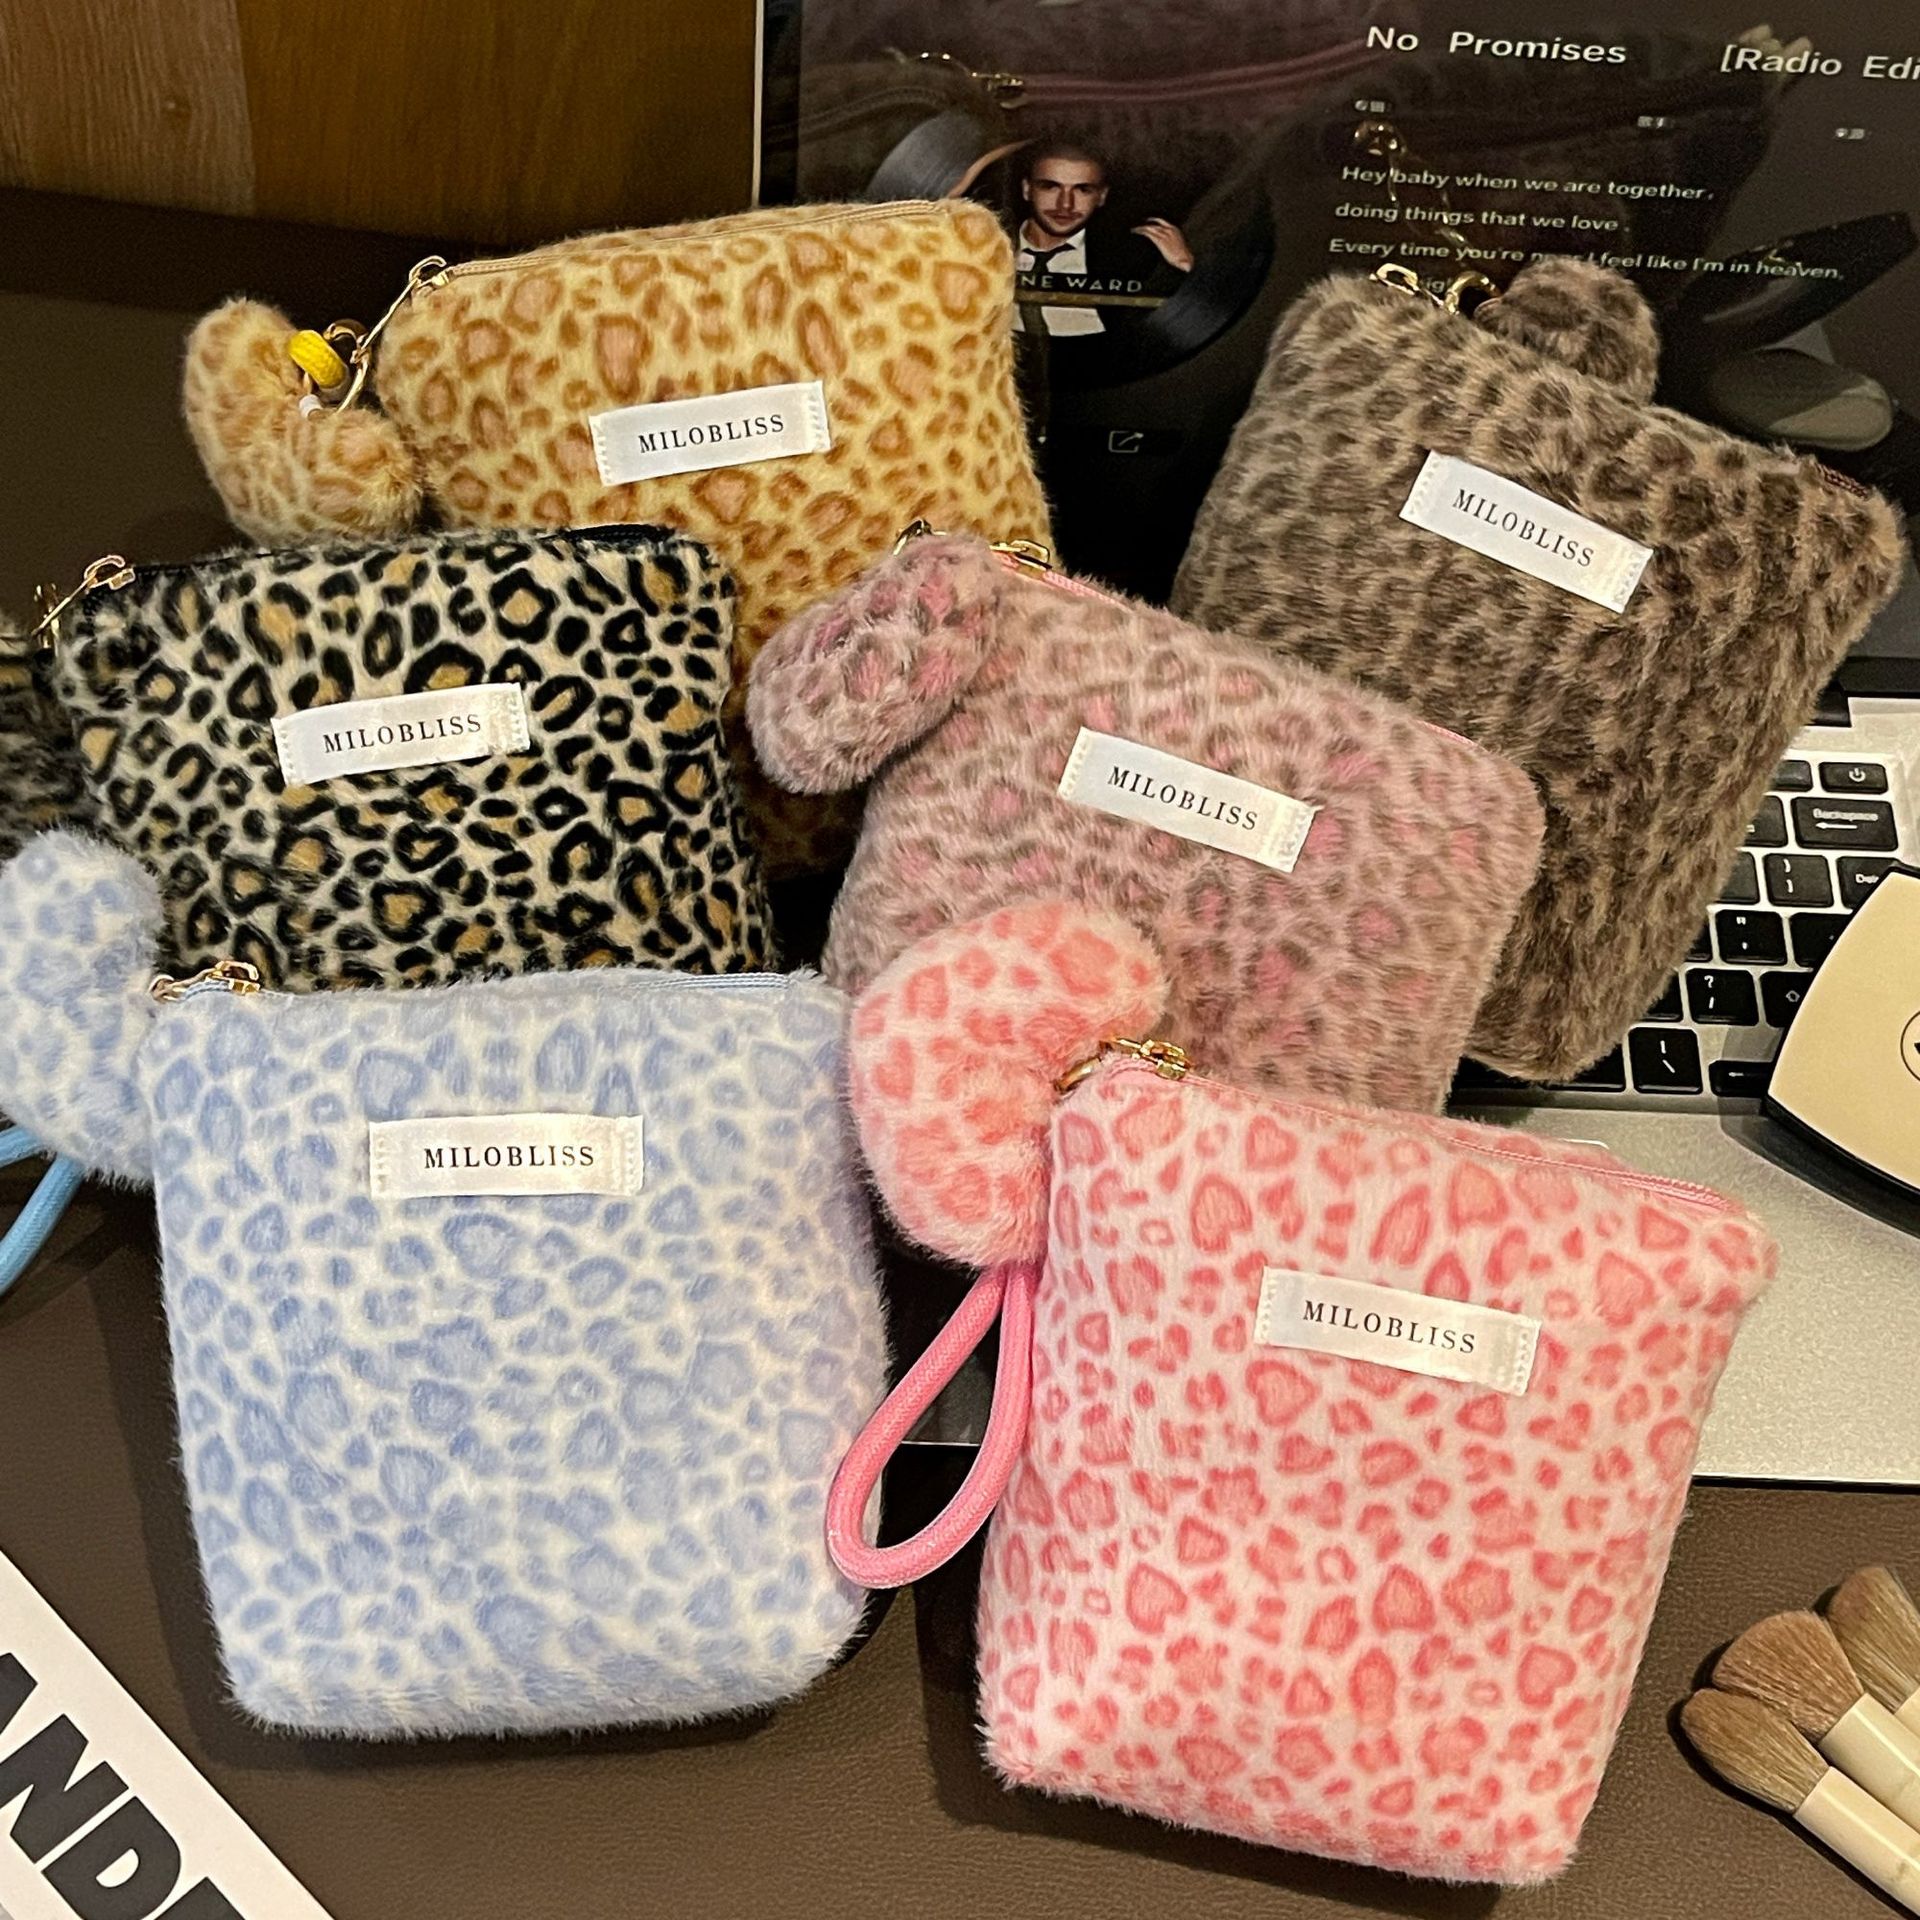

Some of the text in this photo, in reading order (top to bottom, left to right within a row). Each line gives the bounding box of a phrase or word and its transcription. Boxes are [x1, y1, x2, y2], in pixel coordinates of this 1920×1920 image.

[1366, 26, 1419, 51] No
[1449, 31, 1627, 63] Promises
[1720, 44, 1842, 75] [Radio
[1342, 166, 1386, 185] Hey
[1393, 170, 1449, 188] baby
[1455, 173, 1517, 189] when
[1524, 179, 1558, 192] we
[1563, 181, 1601, 194] are
[1335, 203, 1398, 222] doing
[1405, 207, 1474, 226] things
[1481, 211, 1526, 227] that
[1532, 215, 1566, 228] we
[1329, 238, 1394, 258] Every
[1400, 242, 1450, 258] time
[1455, 247, 1525, 261] you're
[1600, 252, 1643, 268] feel
[1647, 256, 1688, 271] like
[1692, 257, 1724, 272] I'm
[1729, 260, 1750, 273] in
[1065, 276, 1143, 293] WARD
[638, 414, 784, 453] MILOBLISS
[1452, 489, 1595, 567] MILOBLISS
[322, 714, 482, 753] MILOBLISS
[1107, 766, 1258, 830] MILOBLISS
[424, 1146, 594, 1169] MILOBLISS
[1302, 1300, 1476, 1354] MILOBLISS
